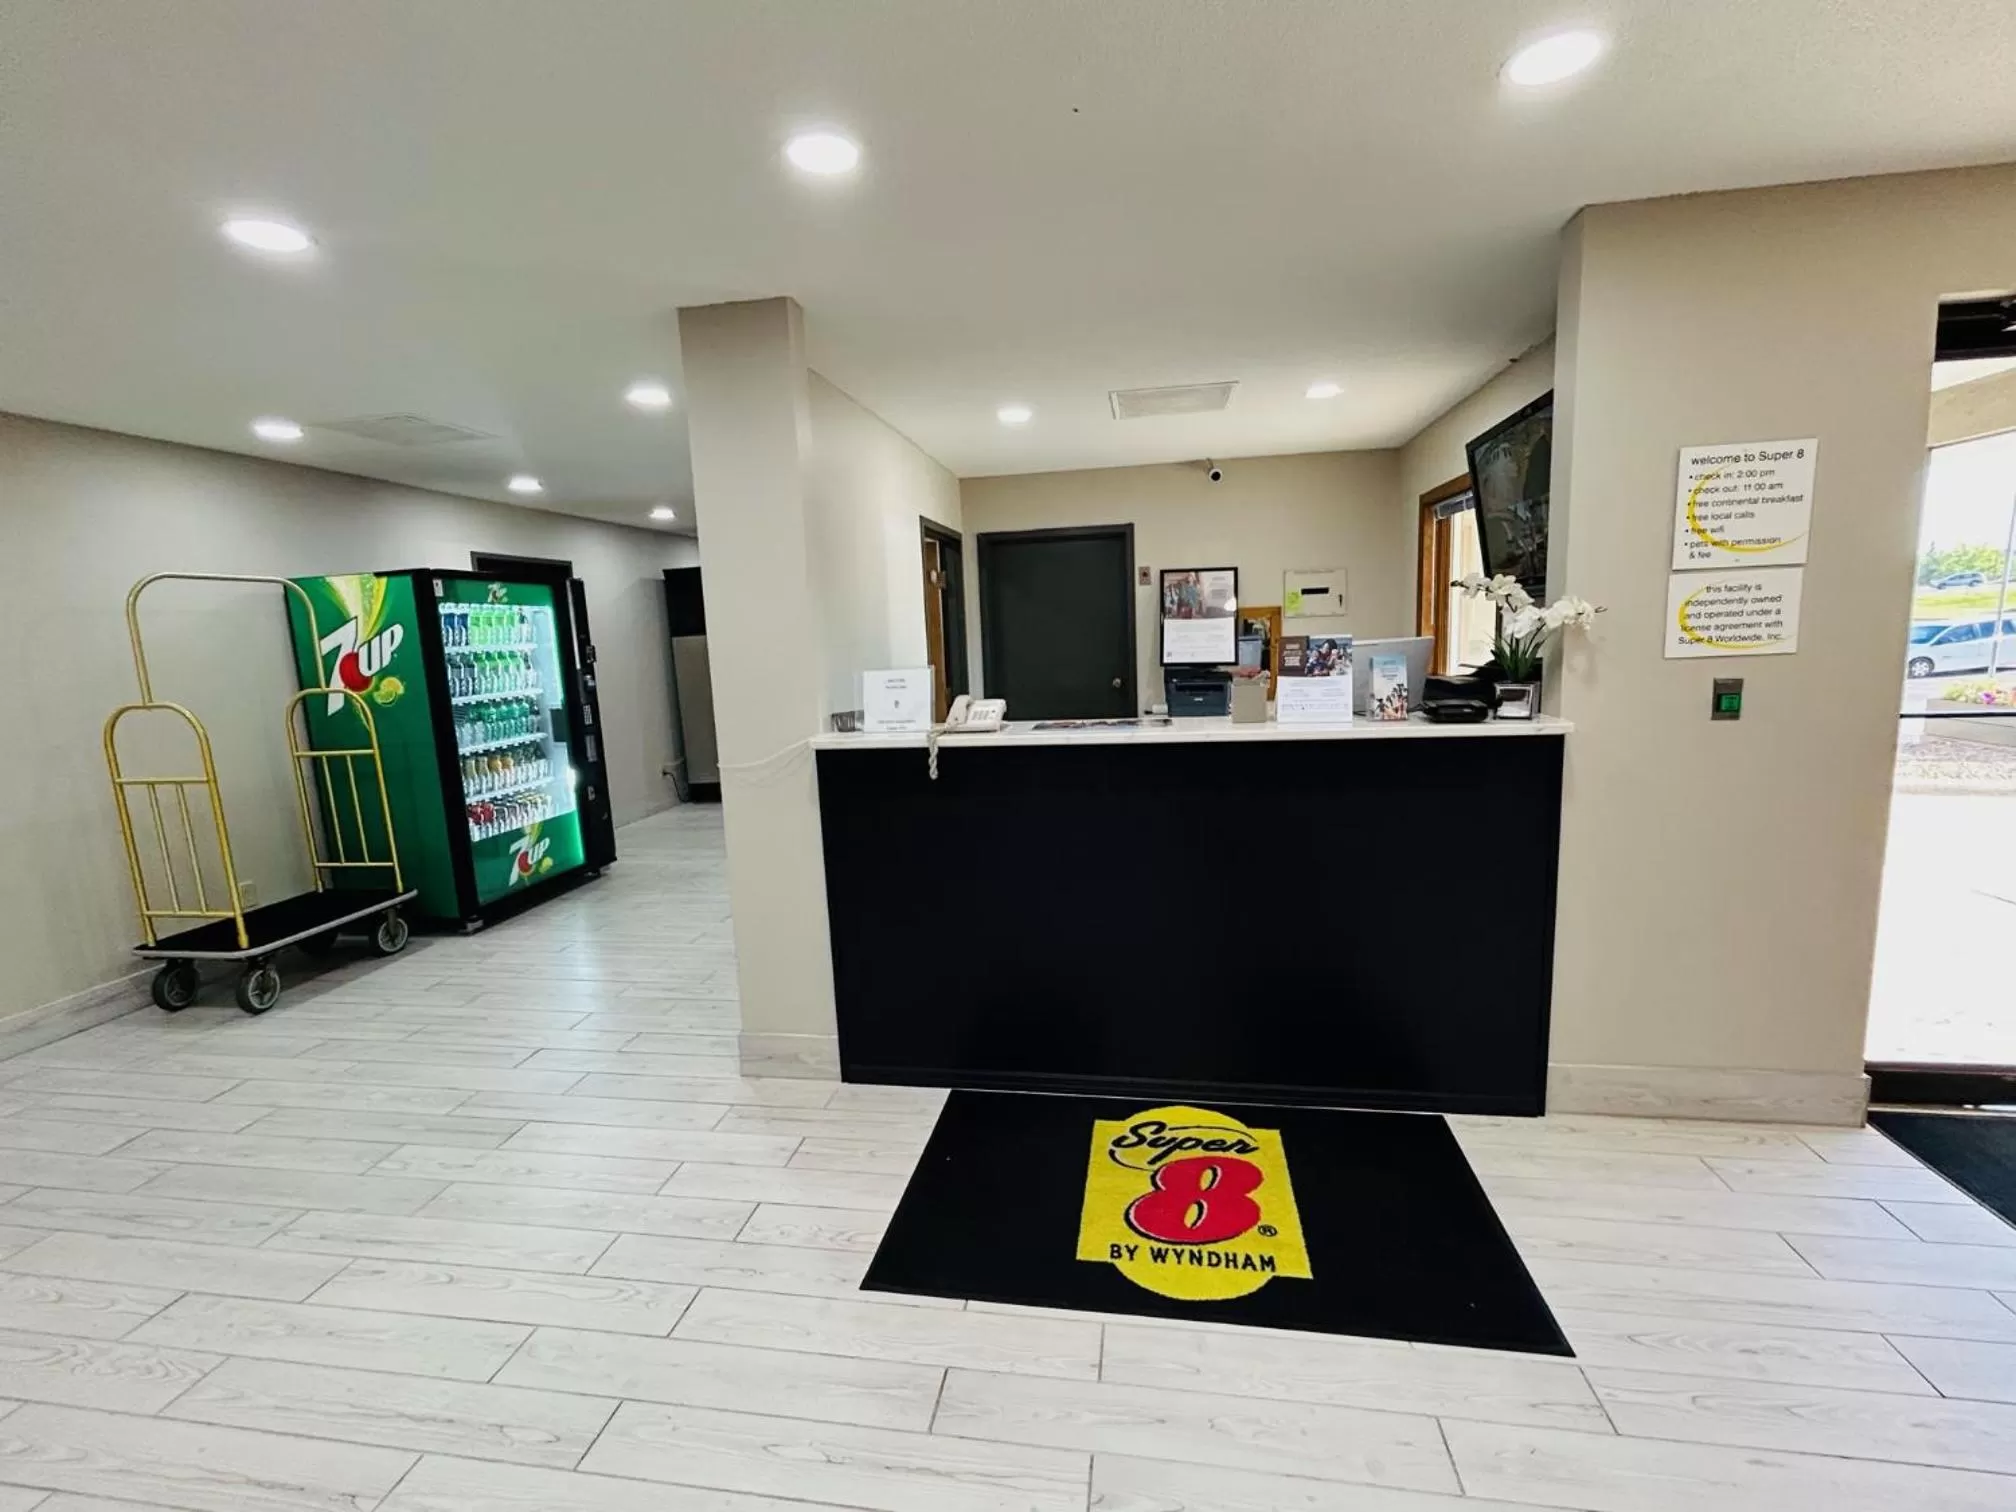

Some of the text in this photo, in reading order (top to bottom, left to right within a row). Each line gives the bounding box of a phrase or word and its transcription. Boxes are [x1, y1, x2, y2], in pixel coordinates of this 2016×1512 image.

[1691, 449, 1804, 466] welcome to Super 8
[1694, 471, 1721, 481] check
[1759, 469, 1775, 478] pm
[1694, 486, 1719, 495] check
[1768, 482, 1784, 490] am
[1692, 494, 1803, 508] free continental breakfast
[1692, 511, 1755, 521] free local calls
[1690, 537, 1781, 548] pets with permission
[1689, 551, 1695, 559] &
[1706, 583, 1762, 593] this facility is
[1685, 595, 1782, 607] independently owned
[1684, 612, 1701, 620] and
[1704, 609, 1744, 619] operated
[1746, 608, 1773, 616] under
[1681, 620, 1782, 632] license agreement with
[1678, 636, 1705, 645] Super
[1111, 1121, 1259, 1166] Super
[1124, 1156, 1264, 1246] 8
[1110, 1244, 1276, 1272] BY WYNDHAM
